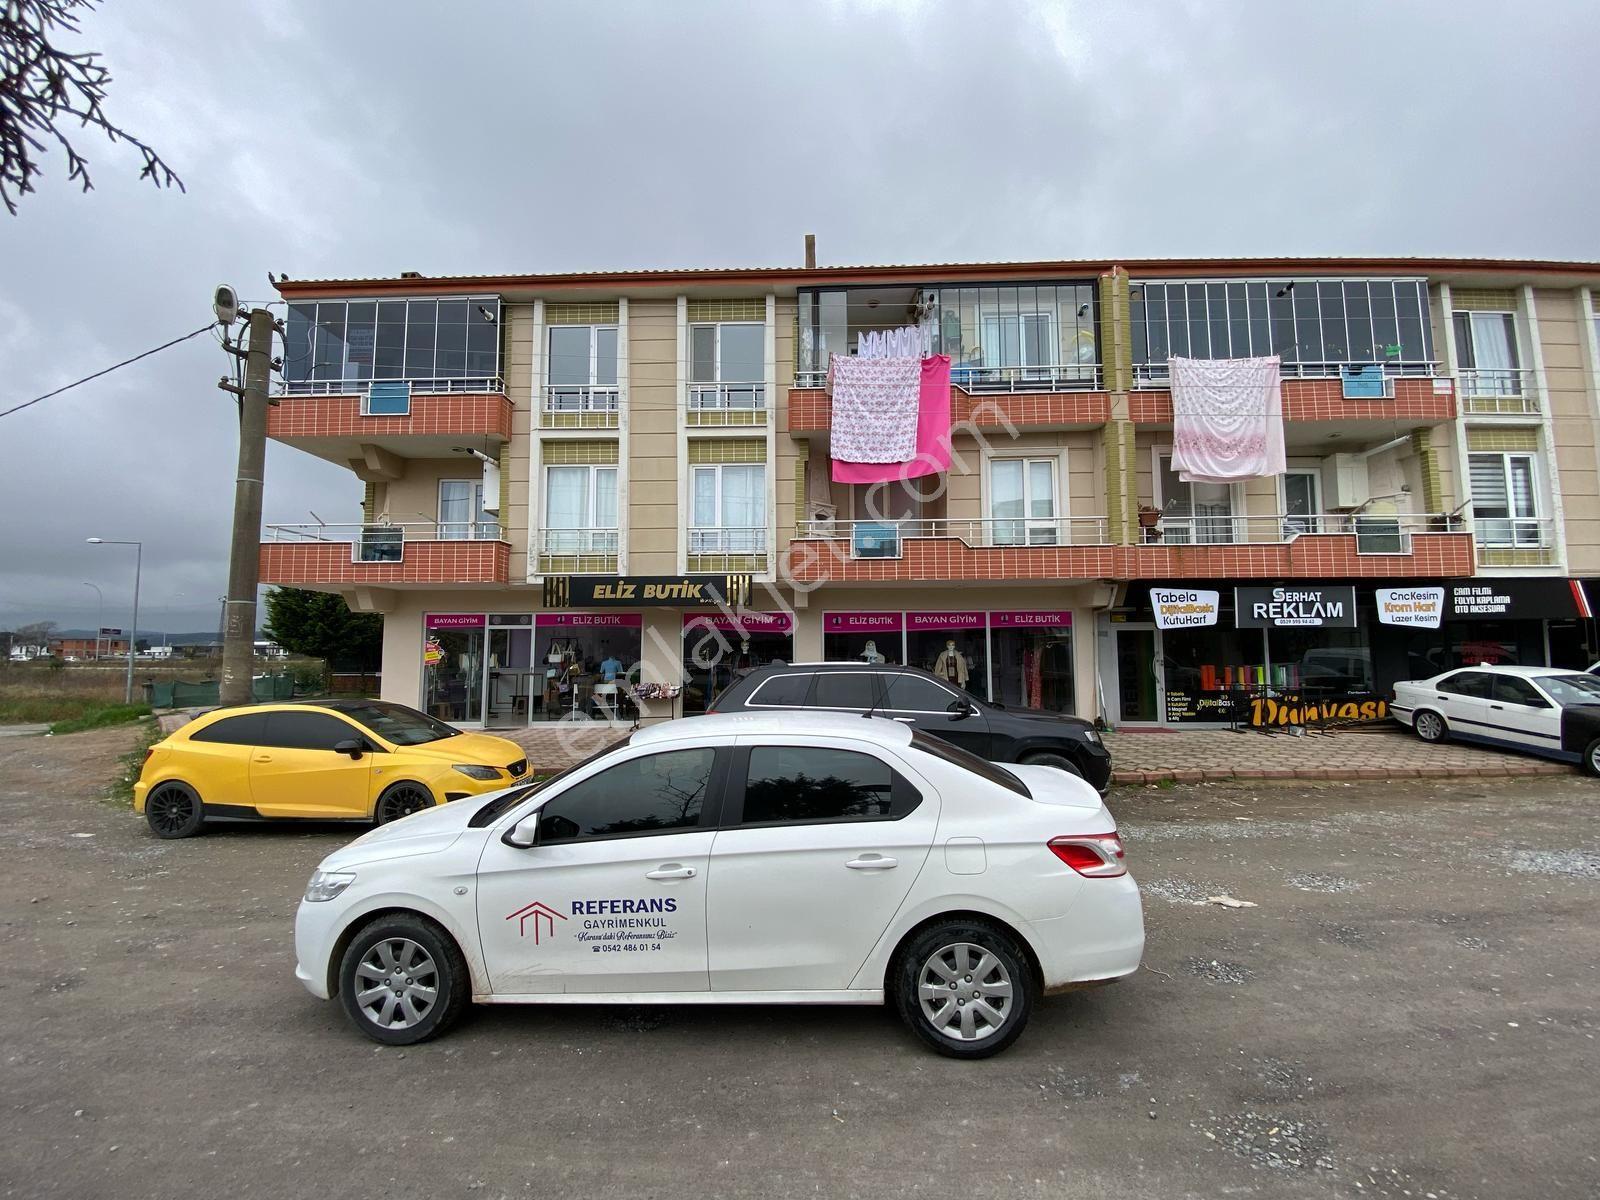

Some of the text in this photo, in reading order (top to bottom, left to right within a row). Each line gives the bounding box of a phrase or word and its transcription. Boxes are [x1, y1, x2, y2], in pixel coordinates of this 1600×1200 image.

[593, 580, 703, 599] ELİZ BUTİK
[1453, 587, 1470, 595] CAM
[1155, 592, 1197, 603] Tabela
[1273, 588, 1321, 602] SERHAT
[1390, 592, 1438, 600] CncKesim
[1476, 596, 1511, 604] KAPLAMA
[1253, 602, 1343, 618] REKLAM
[1384, 602, 1412, 613] Krom
[1455, 604, 1506, 613] OTO AKSESUAR
[572, 614, 621, 624] ELİZ BUTİK
[705, 615, 774, 624] BAYAN GİYİM
[849, 616, 893, 625] ELİZ BUTİK
[949, 614, 977, 623] GİYİM
[1015, 614, 1061, 623] ELİZ BUTİK
[1163, 615, 1206, 625] KutuHarf
[1414, 614, 1438, 622] Kesim
[572, 898, 677, 915] REFERANS
[583, 917, 667, 929] GAYRİMENKUL
[623, 944, 637, 952] 486
[651, 943, 661, 951] 54
